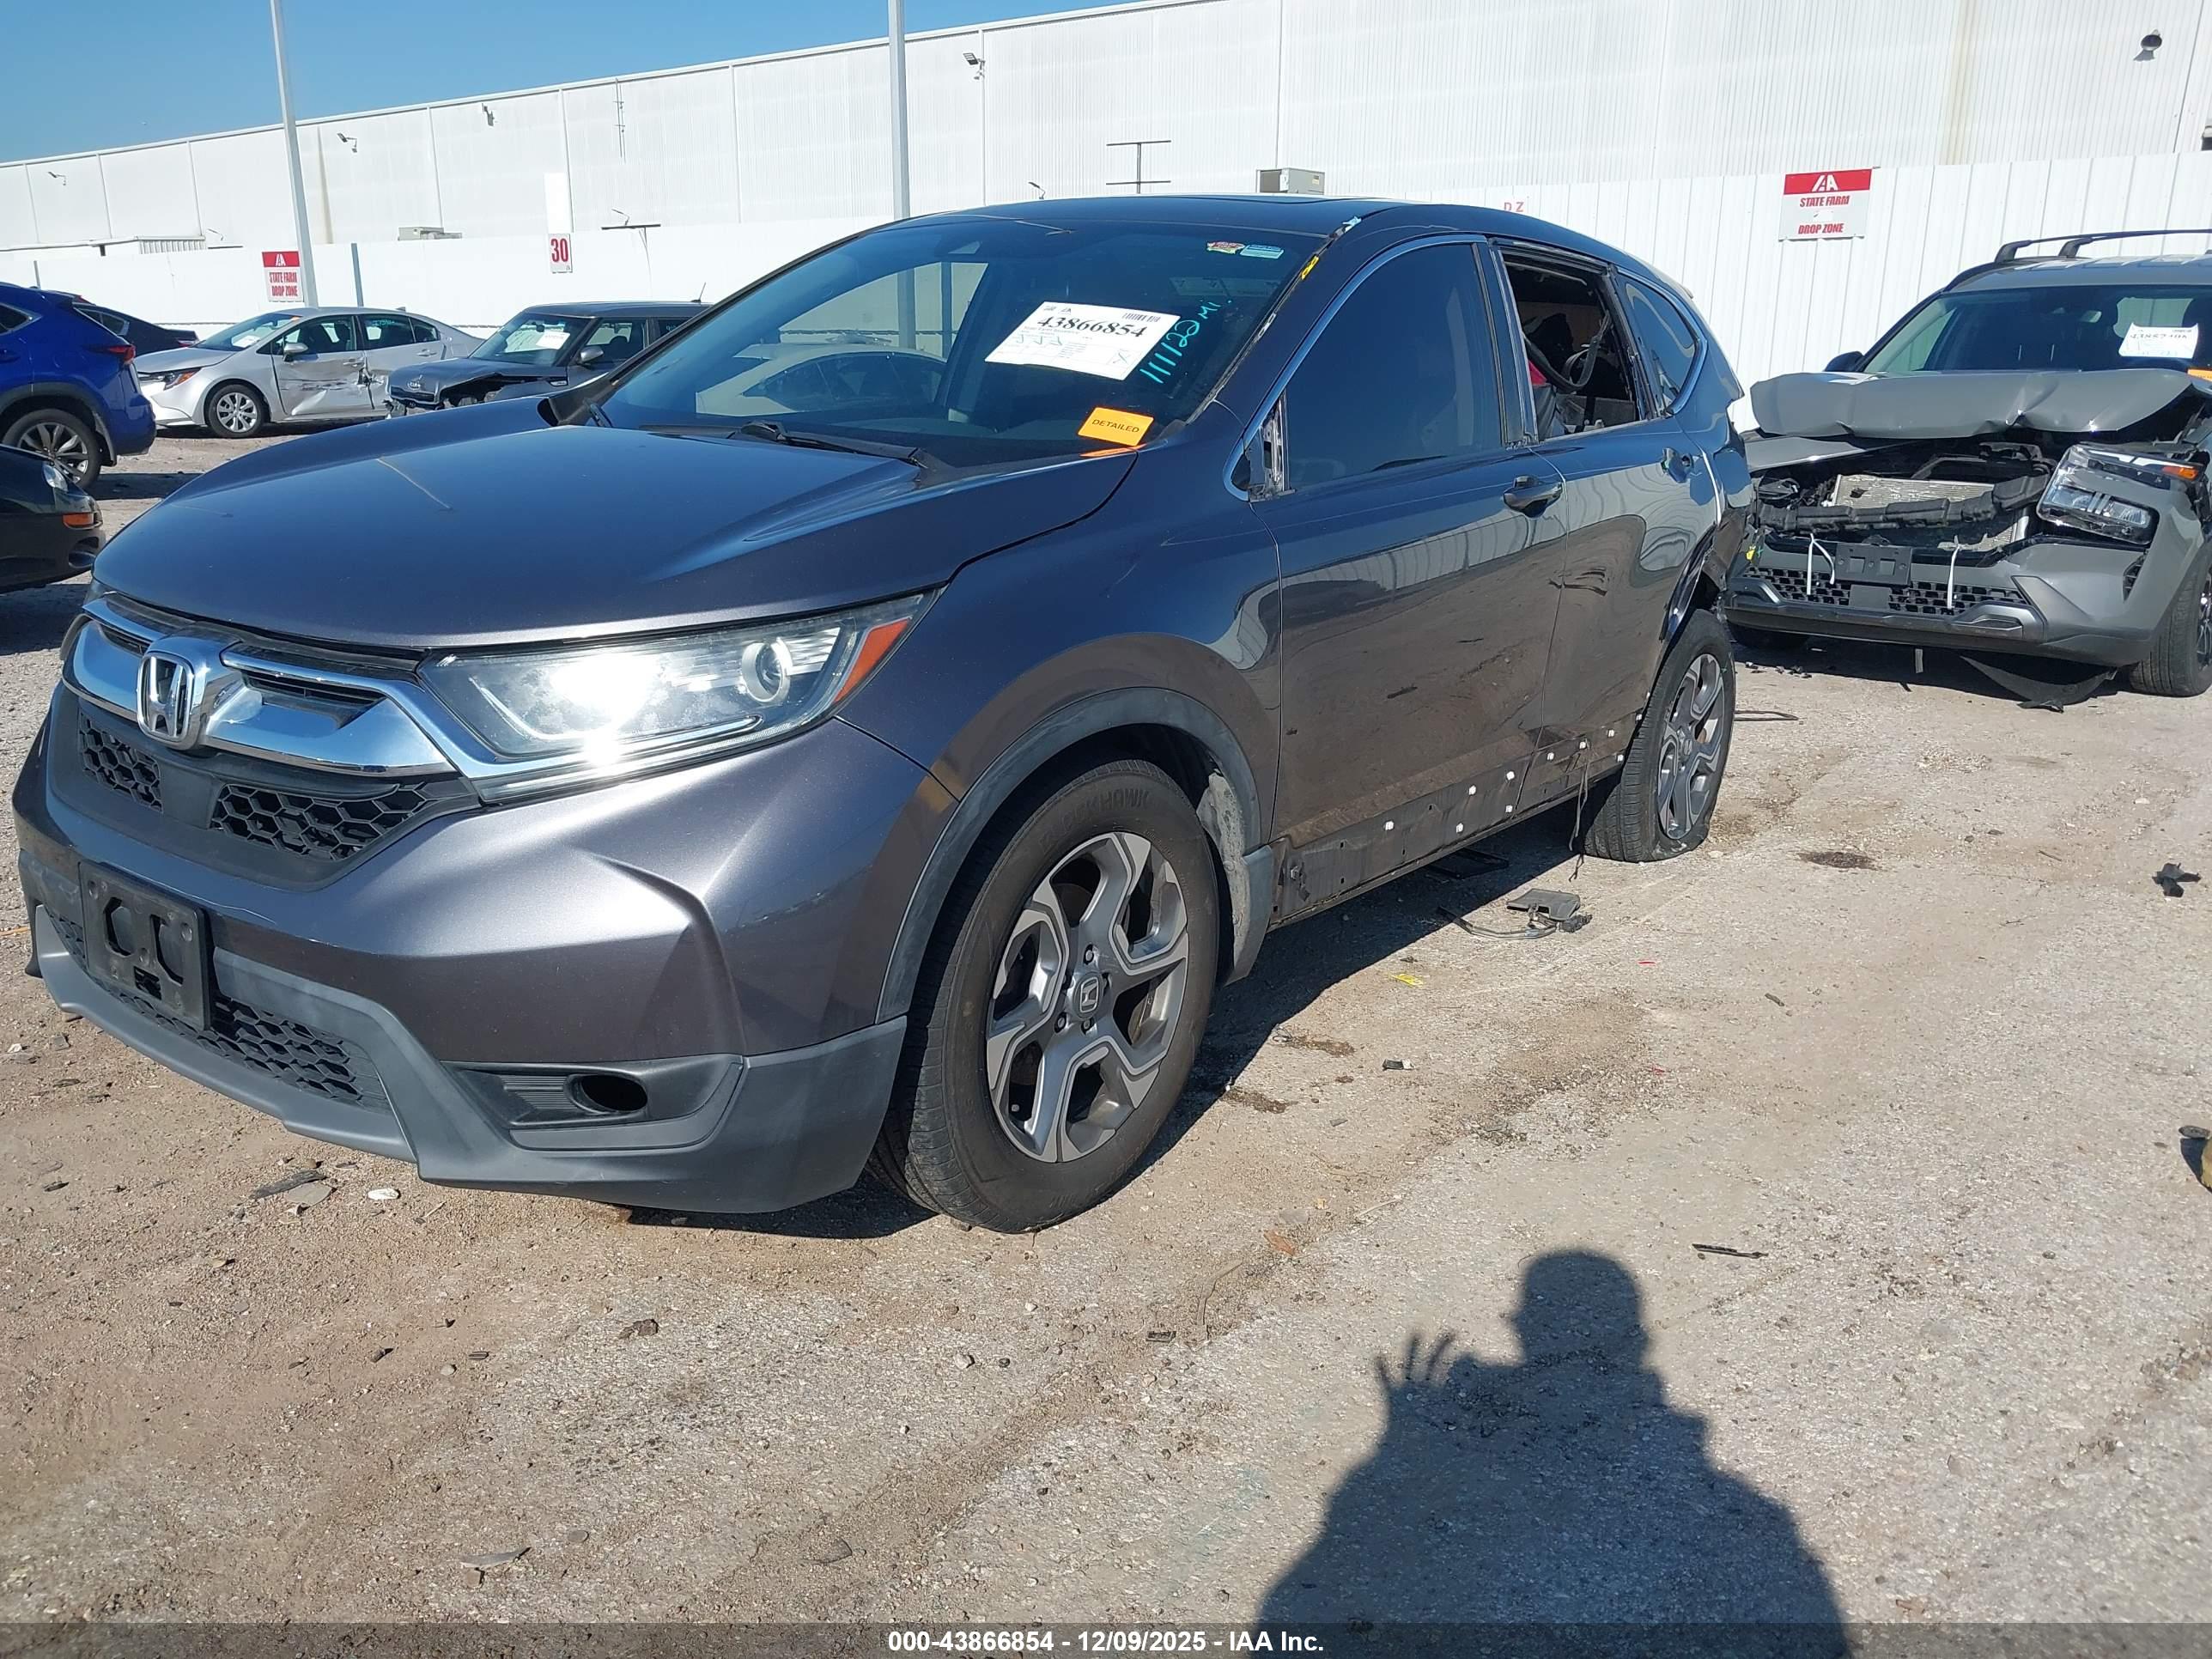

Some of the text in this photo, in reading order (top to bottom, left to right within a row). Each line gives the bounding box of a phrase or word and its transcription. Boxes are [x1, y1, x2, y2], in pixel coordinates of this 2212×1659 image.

[1799, 195, 1850, 208] STATE FARM
[1797, 222, 1844, 234] DROP ZONE
[550, 238, 569, 262] 30
[269, 271, 298, 283] STATE FARM
[271, 285, 299, 297] DROP ZONE
[1036, 315, 1148, 337] 43866854
[1091, 418, 1140, 434] DETAILED
